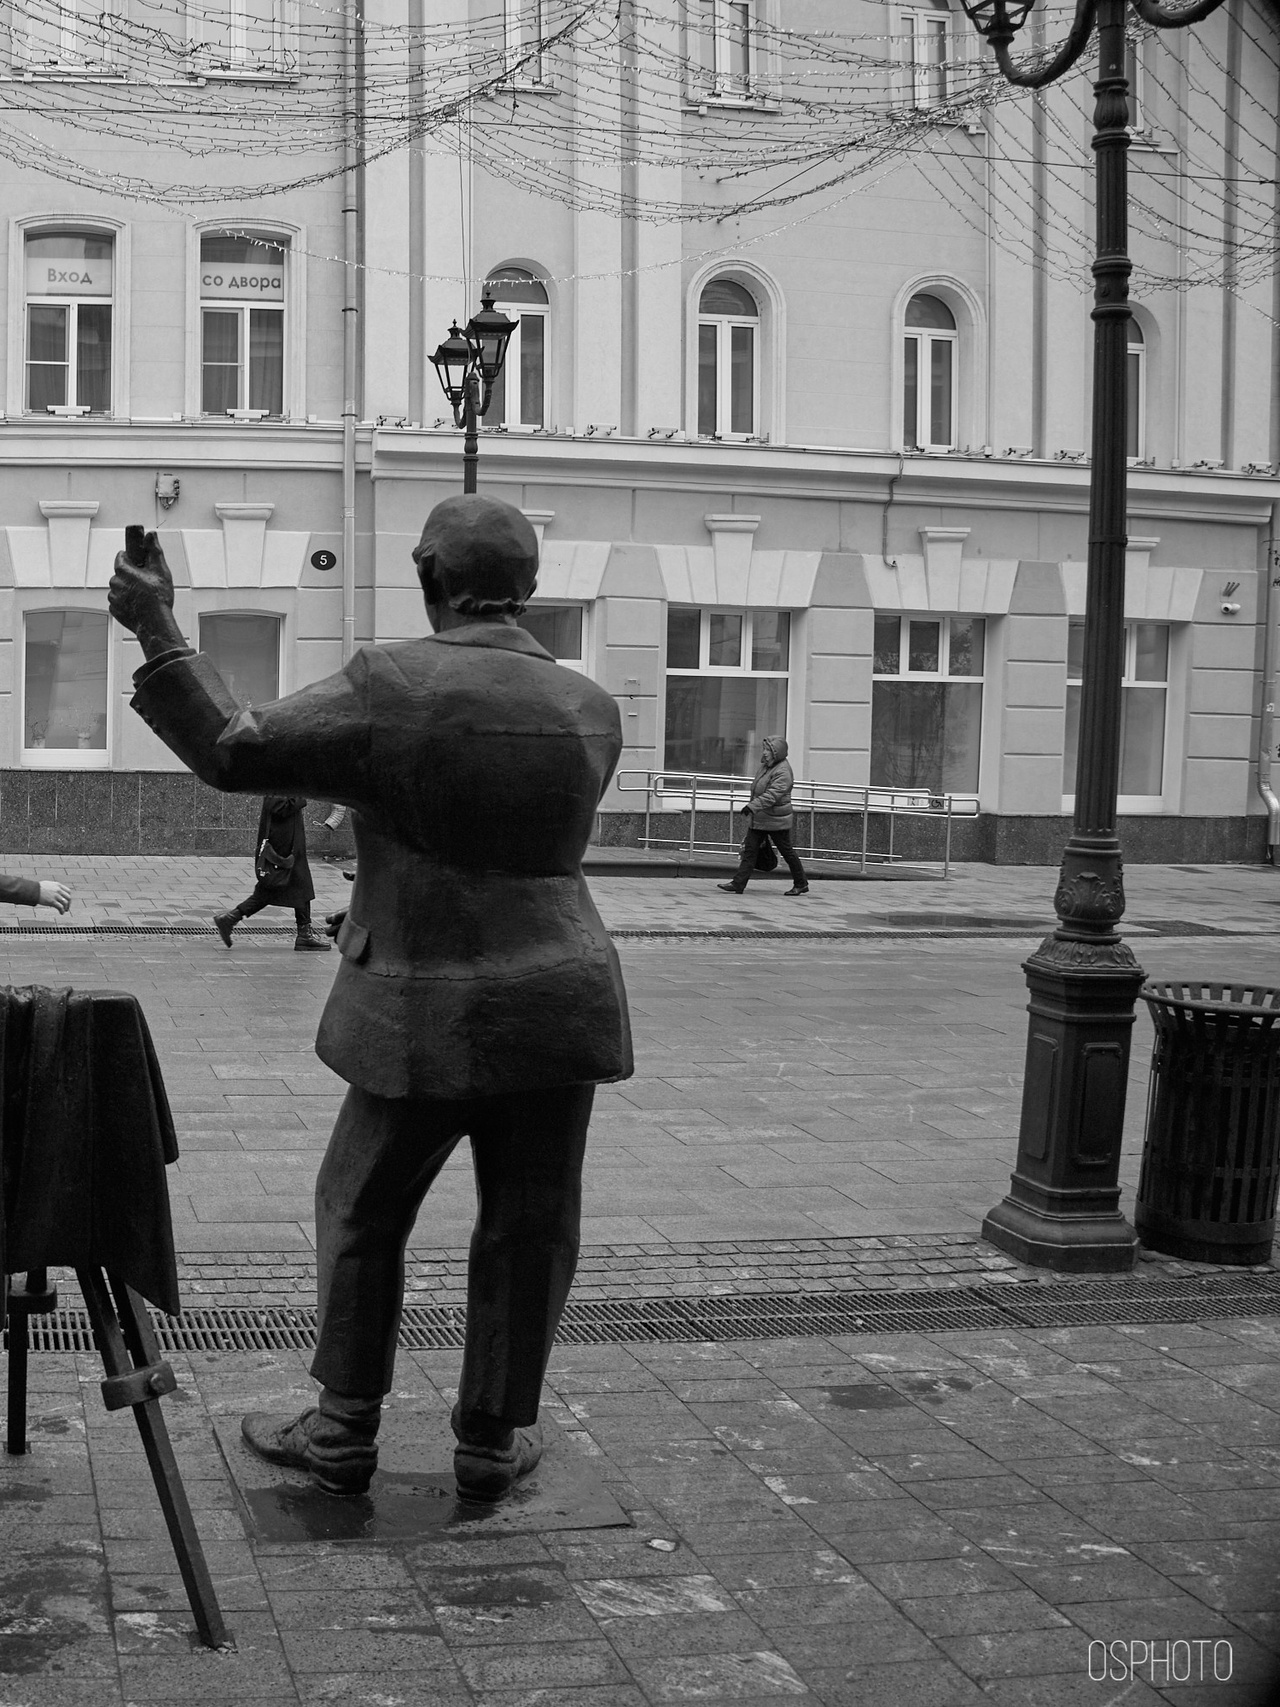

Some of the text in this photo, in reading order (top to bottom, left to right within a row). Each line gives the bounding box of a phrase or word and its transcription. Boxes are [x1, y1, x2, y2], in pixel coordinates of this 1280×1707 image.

[47, 268, 93, 285] Вход
[202, 274, 282, 292] со двора
[319, 554, 328, 566] 5
